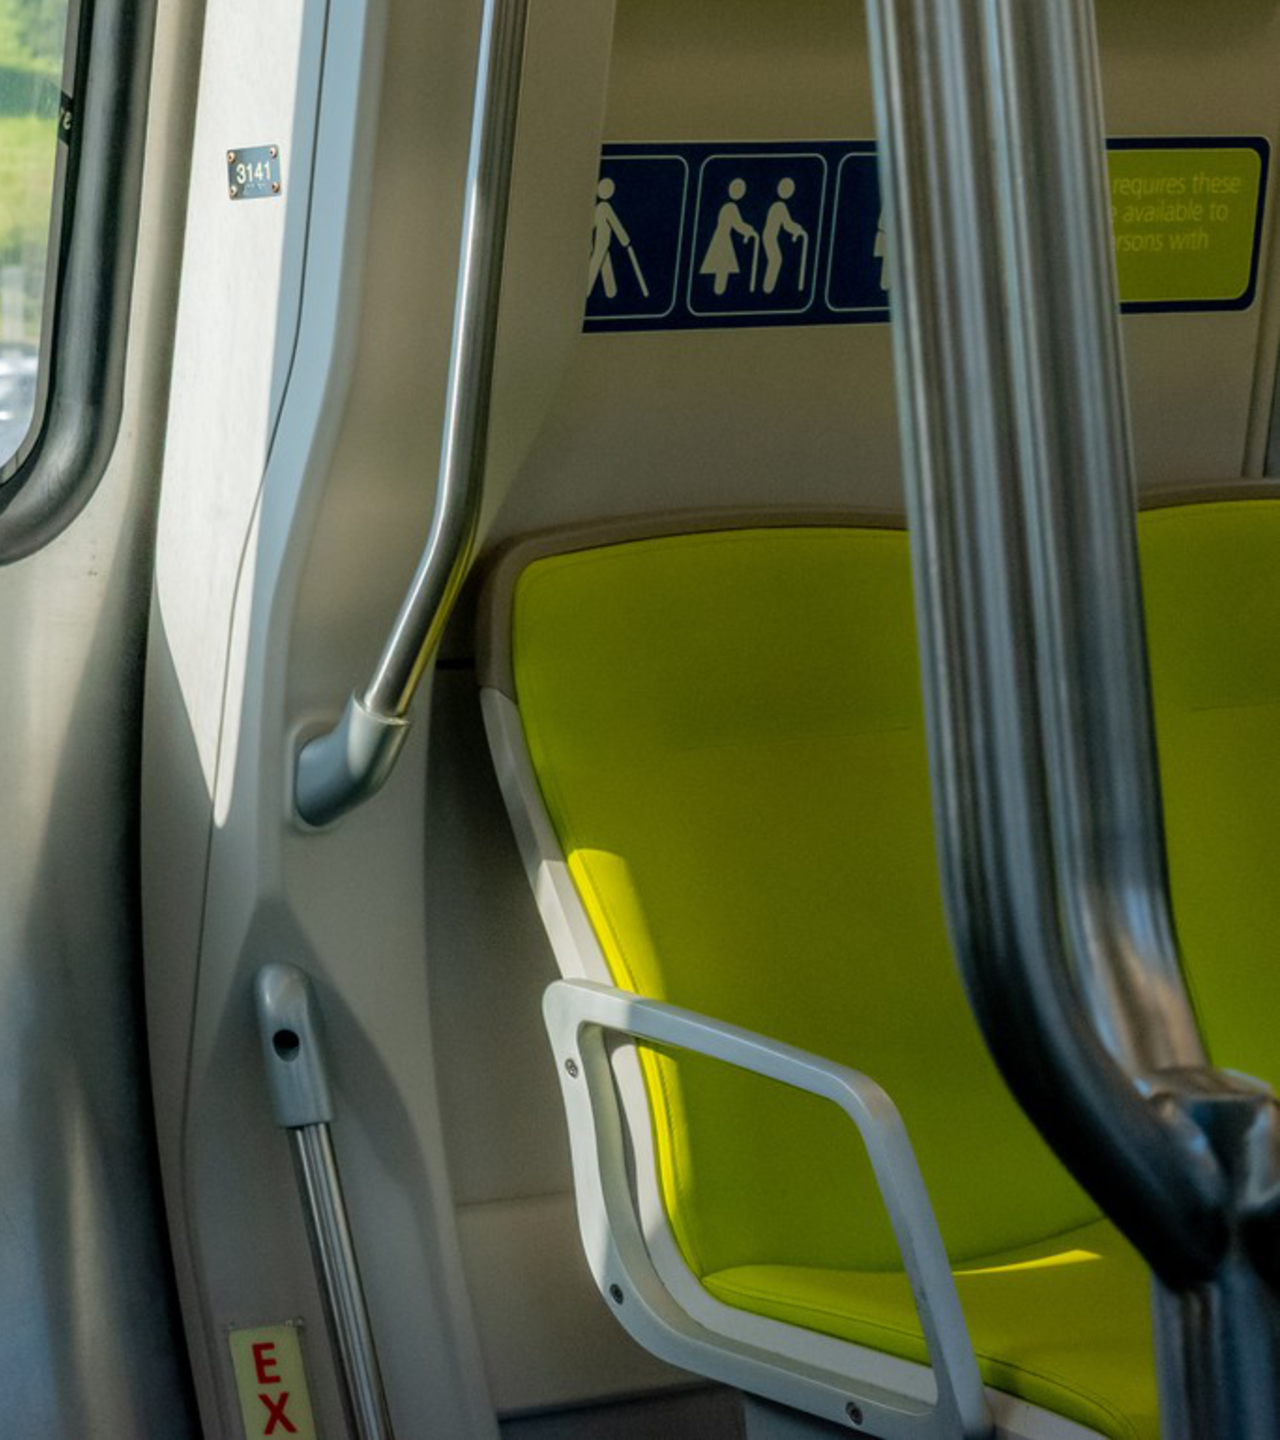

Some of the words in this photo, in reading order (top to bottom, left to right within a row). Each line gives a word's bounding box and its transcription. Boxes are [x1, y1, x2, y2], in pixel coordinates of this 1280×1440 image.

[235, 161, 271, 185] 3141
[1112, 176, 1186, 200] requires
[1191, 171, 1241, 195] these
[1122, 199, 1204, 223] available
[1209, 202, 1229, 222] to
[1168, 227, 1210, 251] with
